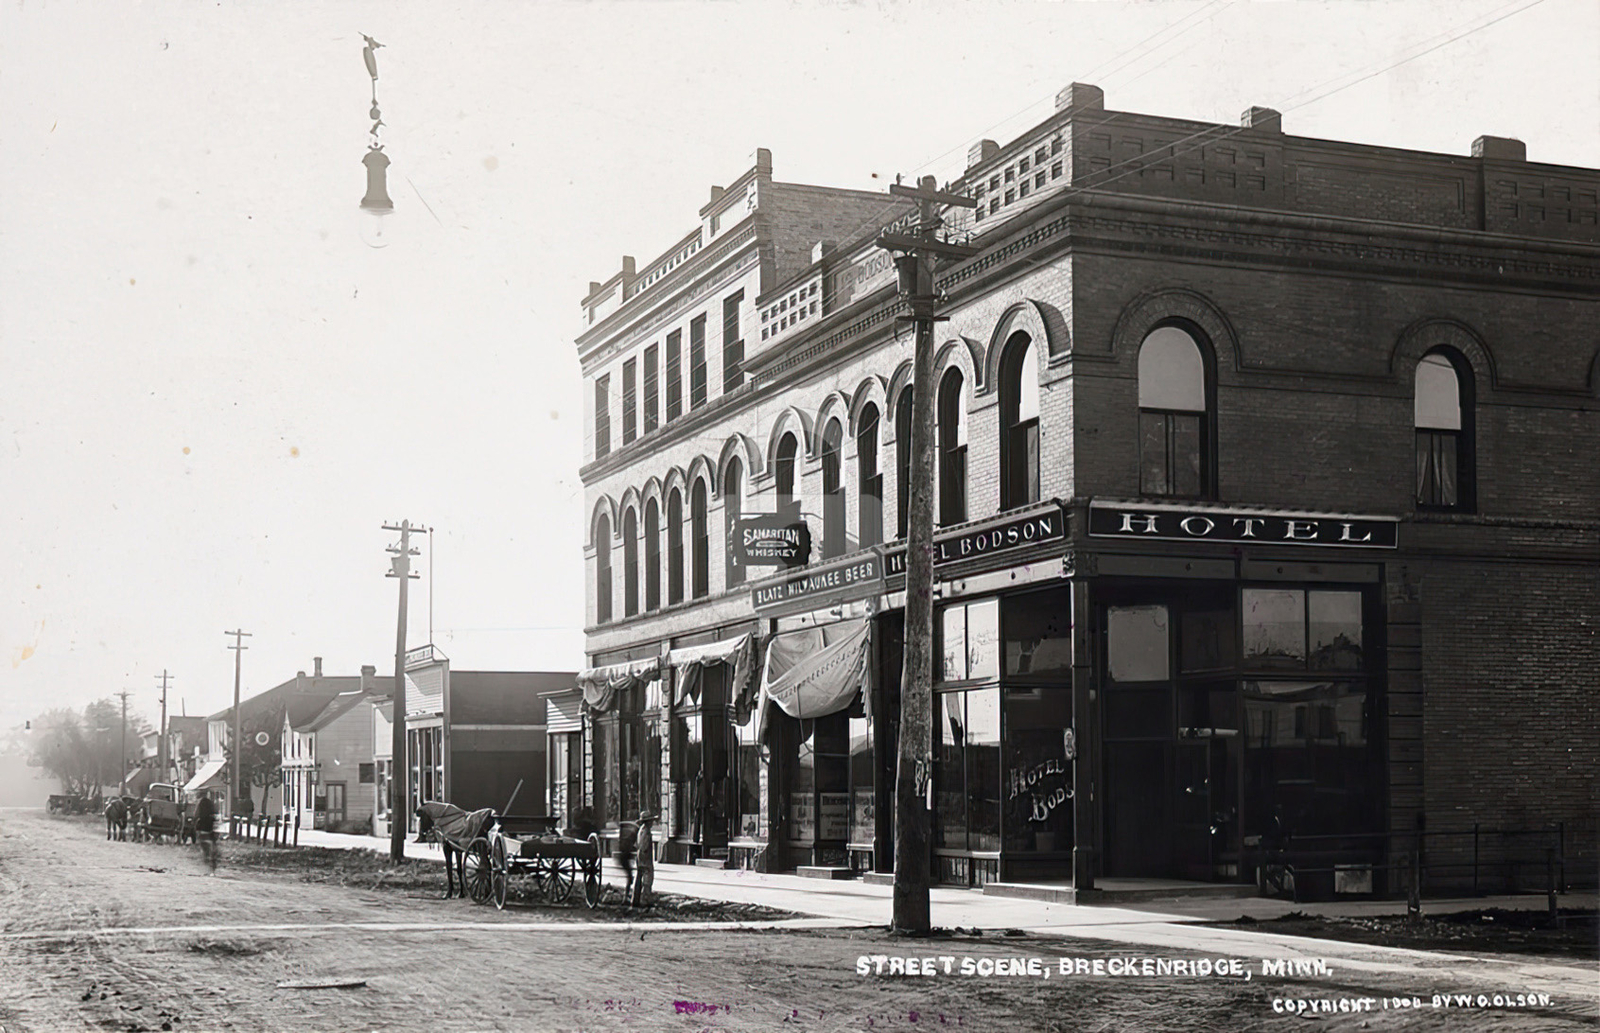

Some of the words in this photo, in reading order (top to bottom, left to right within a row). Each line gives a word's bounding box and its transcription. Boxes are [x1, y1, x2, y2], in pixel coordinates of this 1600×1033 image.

[743, 528, 800, 547] SAMARITAN
[1119, 513, 1371, 542] HOTEL
[745, 548, 798, 558] WHISKEY
[891, 543, 950, 572] HEL
[960, 517, 1053, 556] BODSON
[757, 586, 782, 604] BLATZ
[788, 571, 840, 596] MILWAUKEE
[845, 562, 873, 582] BEER
